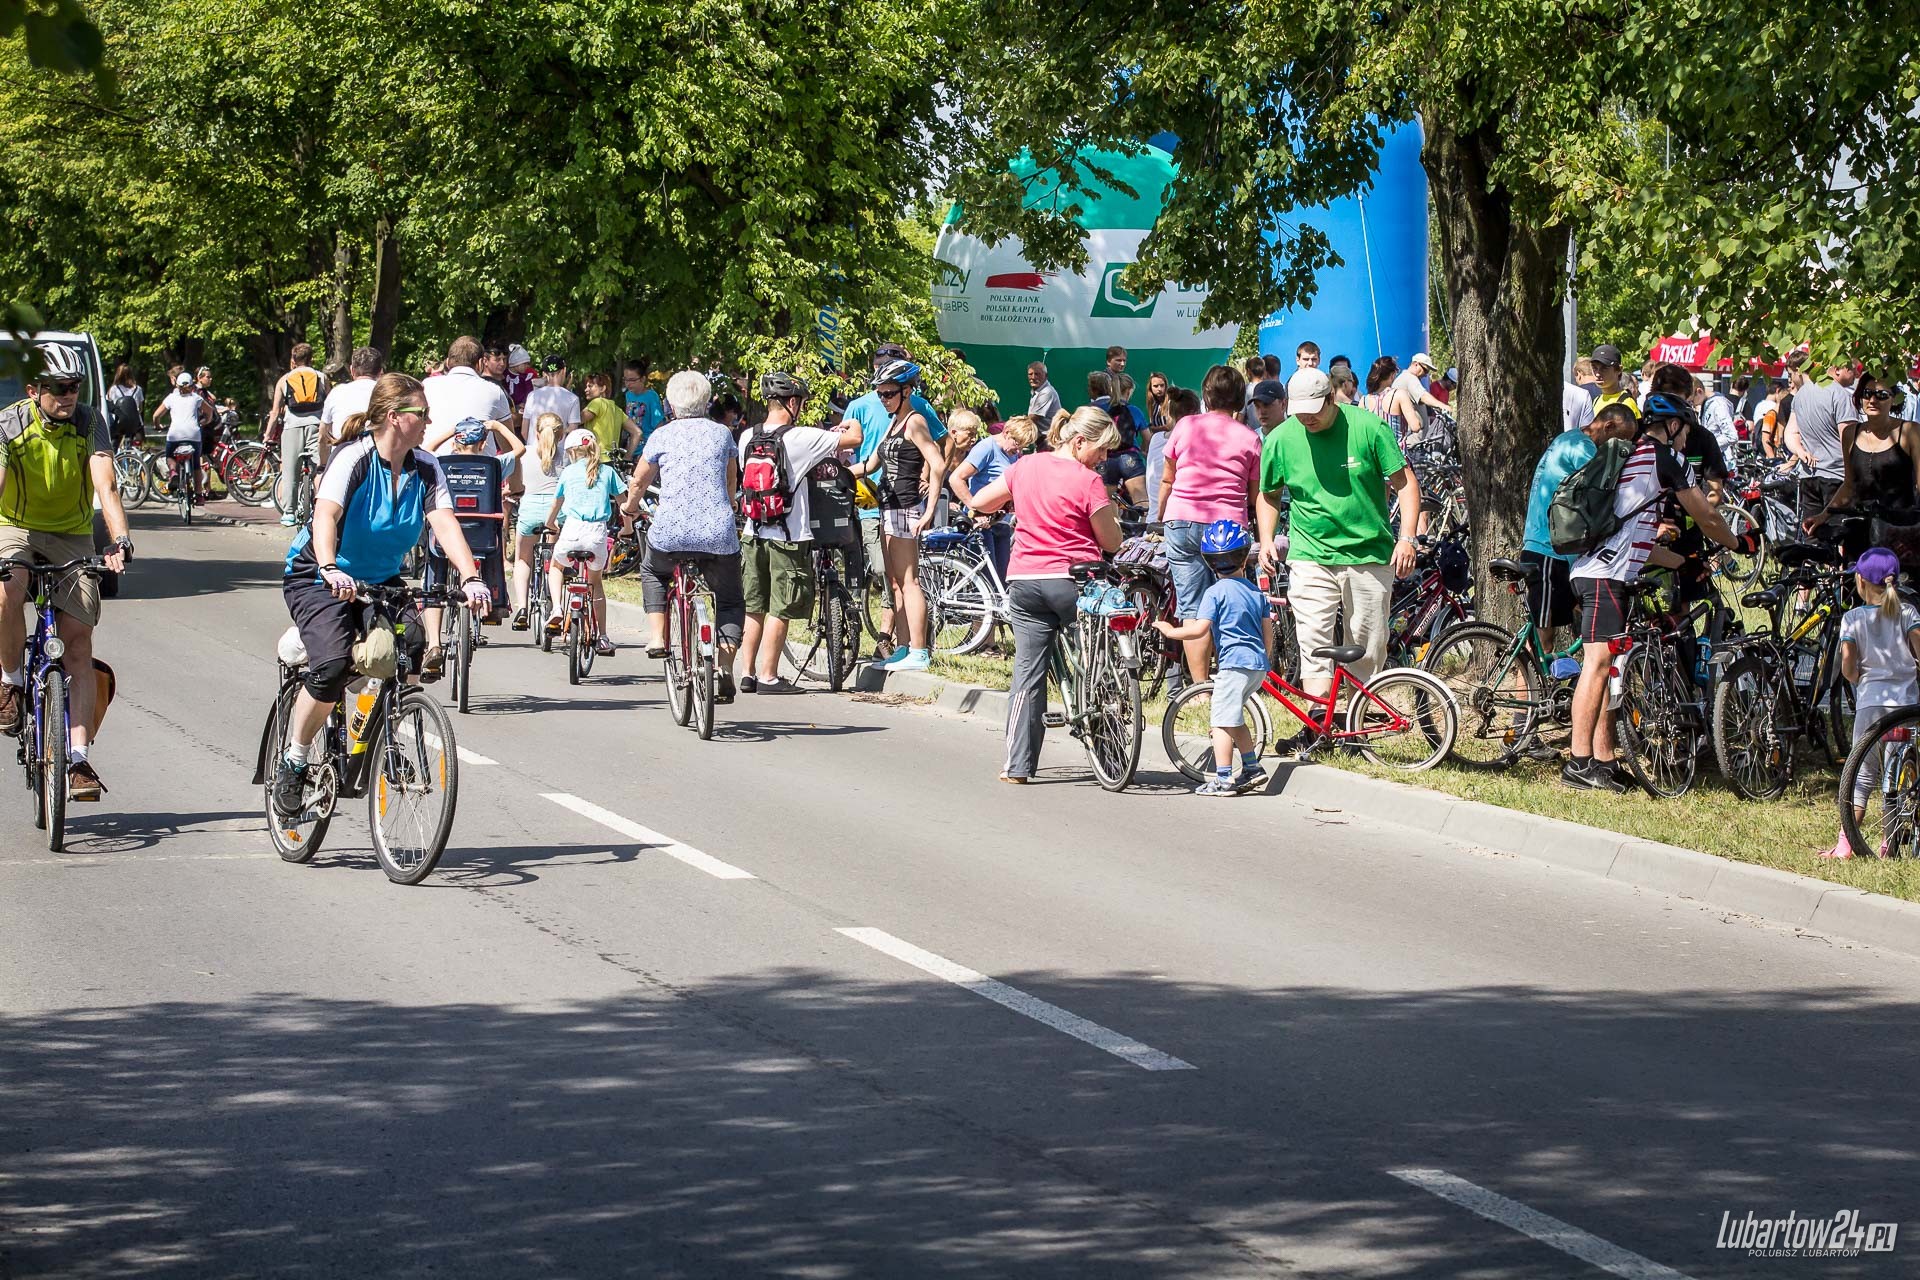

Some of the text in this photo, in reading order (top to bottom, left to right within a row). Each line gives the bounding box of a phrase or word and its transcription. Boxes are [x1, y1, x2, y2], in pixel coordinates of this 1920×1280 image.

[990, 294, 1040, 303] POLSKI BANK
[986, 304, 1010, 312] POLSKI
[1038, 316, 1055, 324] 1903
[1659, 342, 1699, 364] TYSKIE
